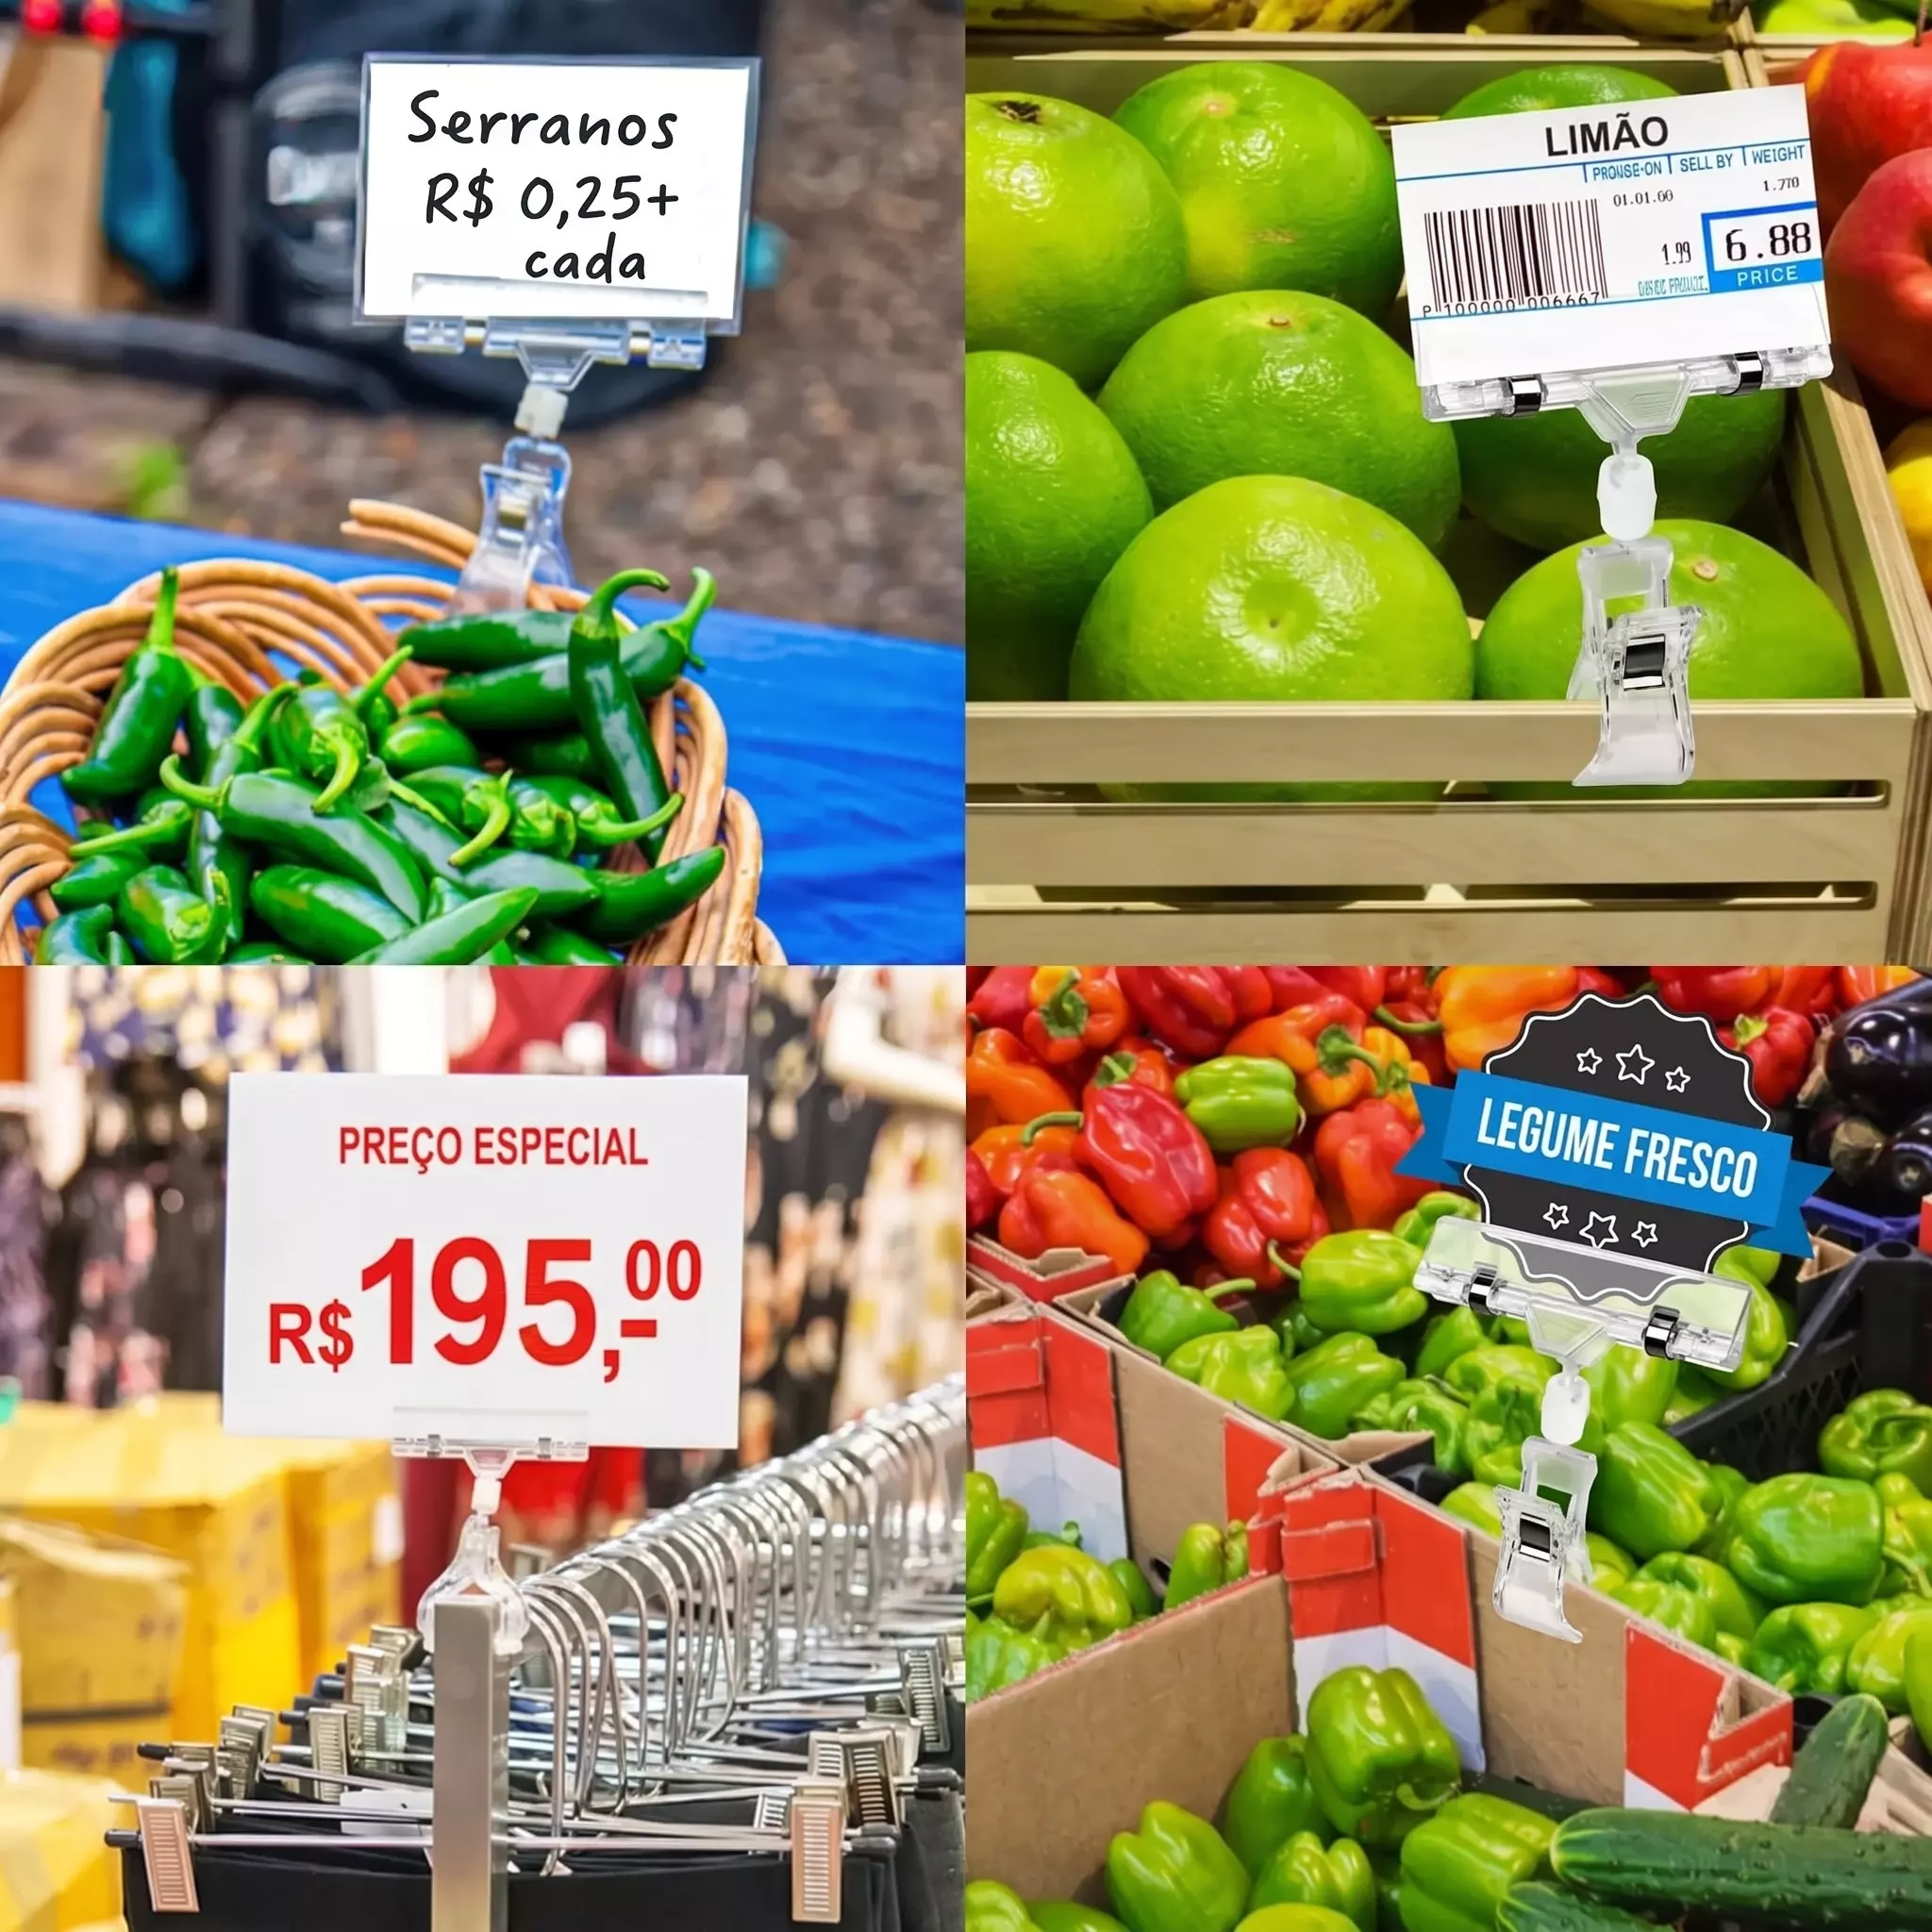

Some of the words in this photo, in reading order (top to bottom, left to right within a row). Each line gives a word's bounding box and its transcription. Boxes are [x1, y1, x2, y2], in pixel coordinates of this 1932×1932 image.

[408, 90, 677, 149] Serranos
[1545, 112, 1669, 158] LIMÃO
[1680, 156, 1712, 173] SELL
[1717, 153, 1733, 169] BY
[1752, 144, 1806, 164] WEIGHT
[425, 168, 493, 227] R$
[521, 175, 679, 230] 0,25+
[525, 232, 646, 283] cada
[1661, 241, 1691, 265] 1.99
[1725, 222, 1811, 261] 6.88
[1737, 265, 1799, 287] PRICE
[339, 1125, 461, 1174] PREÇO
[474, 1125, 649, 1166] ESPECIAL
[1476, 1097, 1620, 1170] LEGUME
[1624, 1129, 1758, 1198] FRESCO
